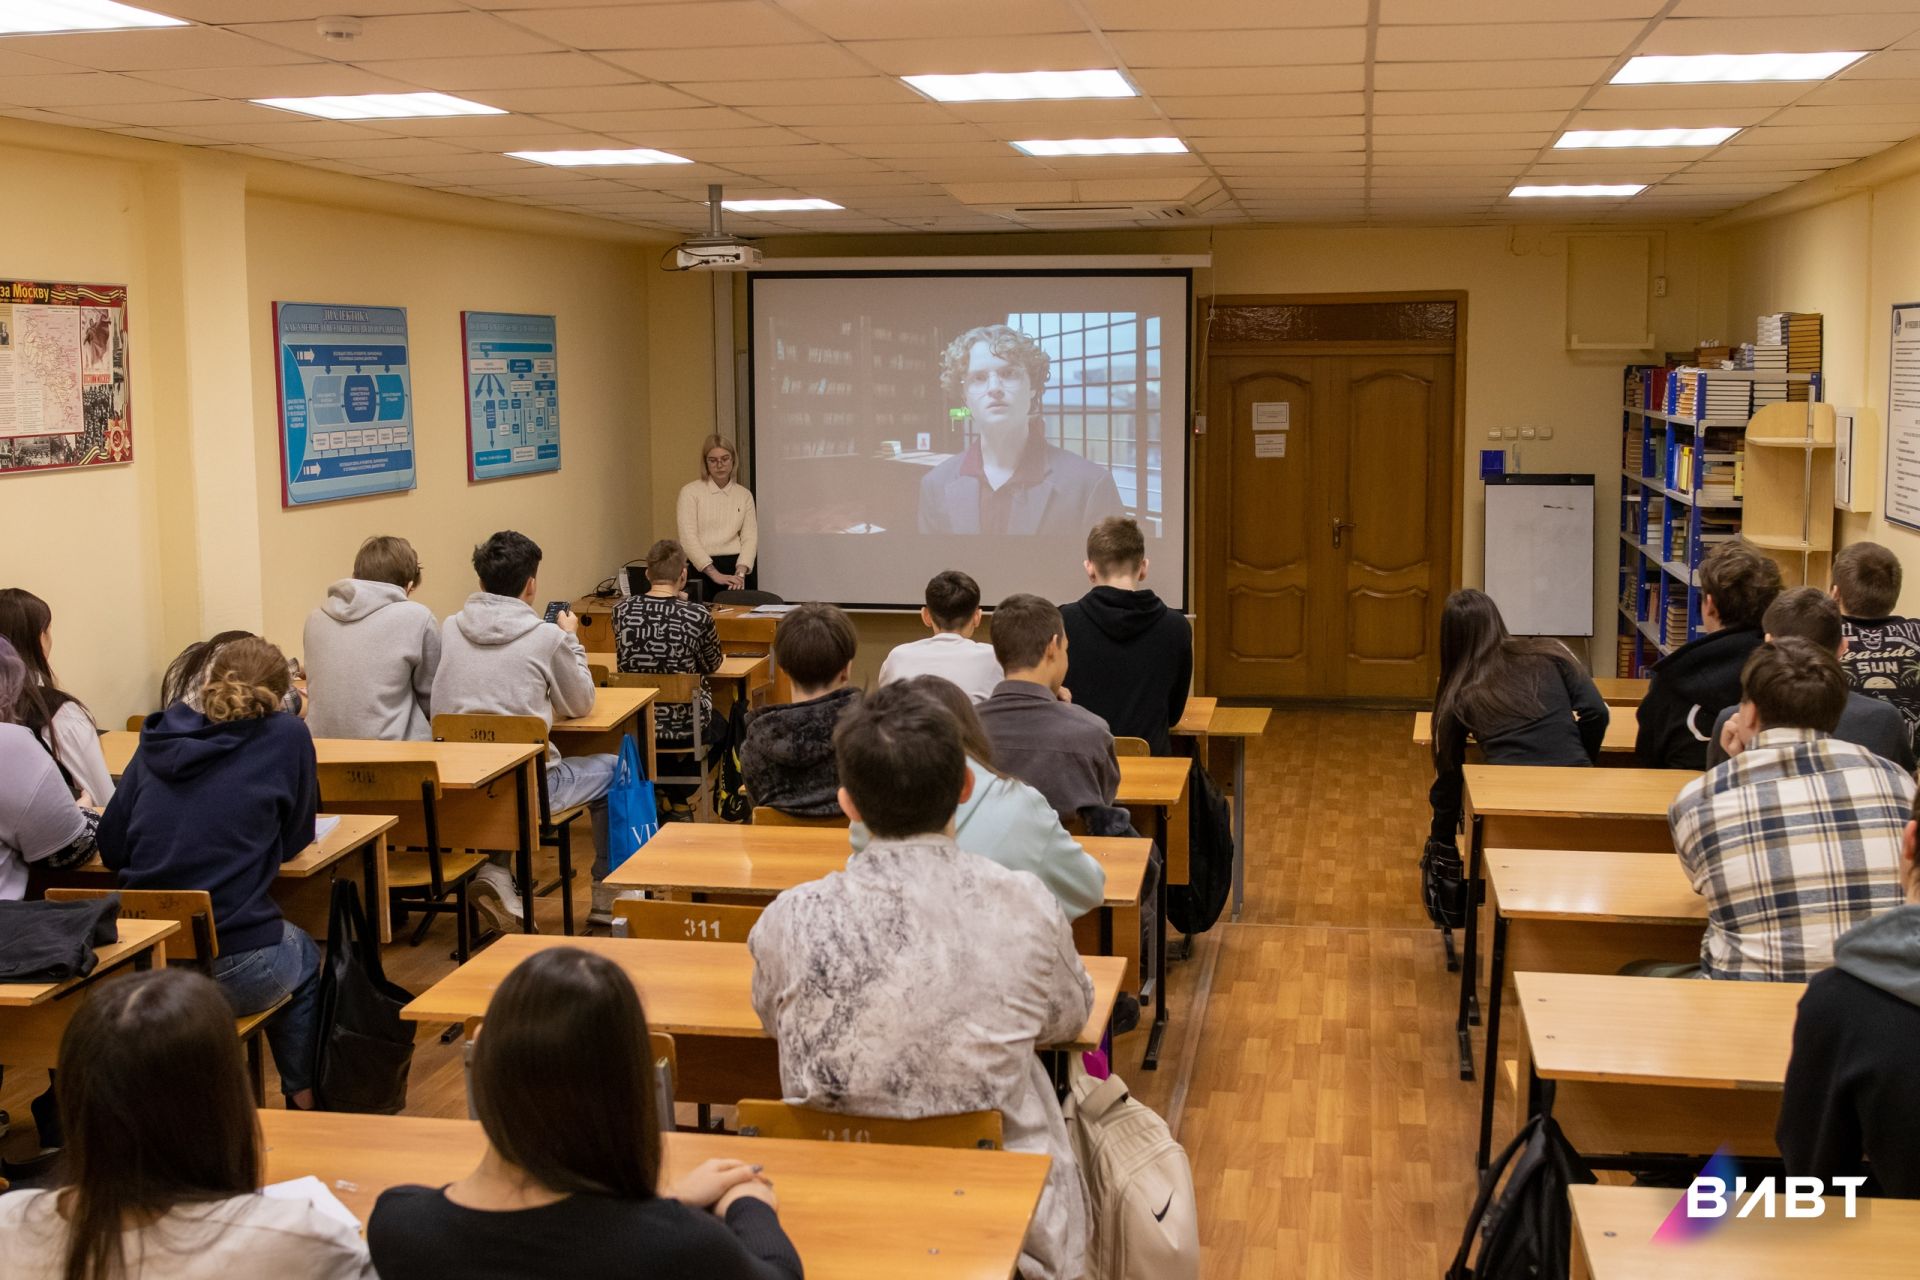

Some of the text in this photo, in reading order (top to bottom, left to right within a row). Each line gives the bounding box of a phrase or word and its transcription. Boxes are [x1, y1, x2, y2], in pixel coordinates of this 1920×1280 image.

[0, 283, 49, 303] за Москву
[323, 309, 369, 322] ДИАЛЕКТИКА
[1856, 661, 1899, 675] SUN
[470, 728, 496, 742] 303
[683, 918, 721, 939] 311
